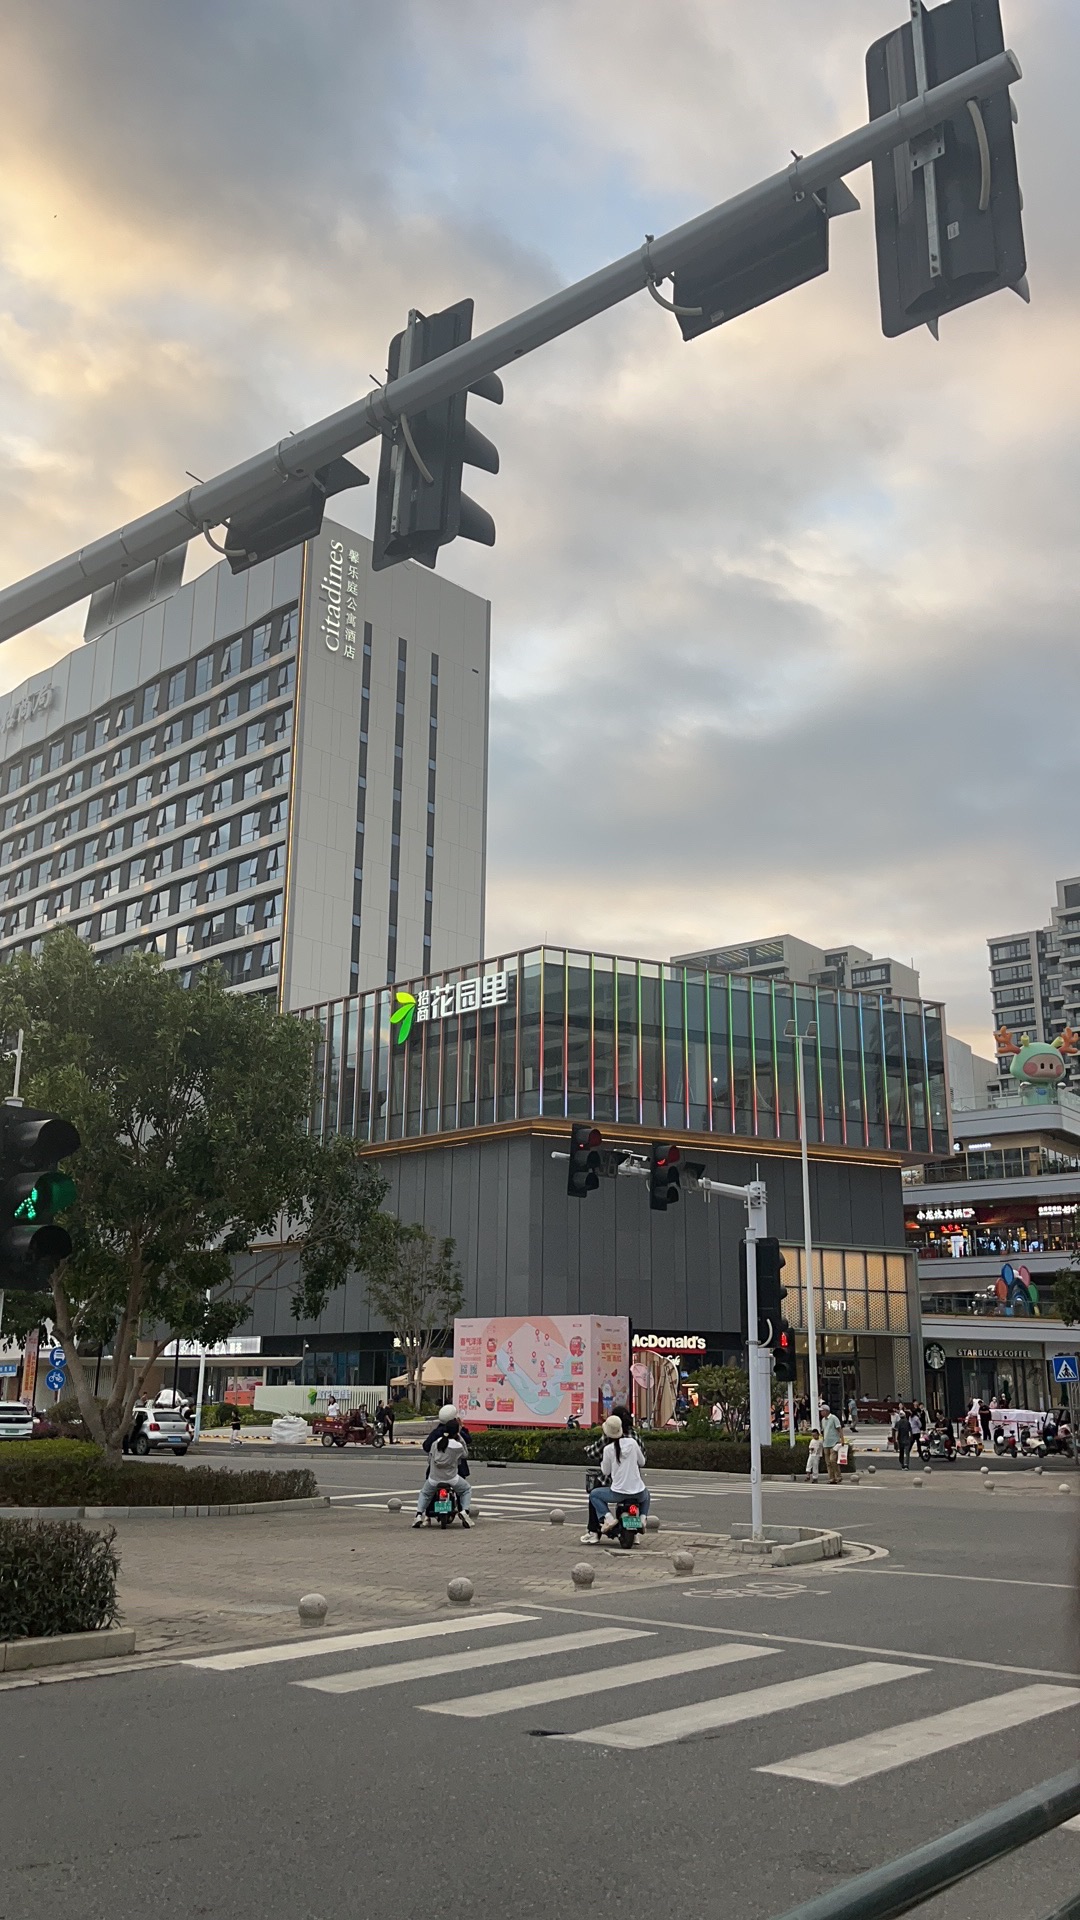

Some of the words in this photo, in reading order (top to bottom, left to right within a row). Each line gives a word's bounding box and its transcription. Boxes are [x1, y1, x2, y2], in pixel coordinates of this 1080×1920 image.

[343, 549, 360, 660] 馨乐庭公寓酒店
[826, 1300, 847, 1311] 1号门
[632, 1334, 707, 1349] McDonald's
[957, 1349, 1003, 1357] STARBUCKS
[1003, 1350, 1032, 1358] COFFEE
